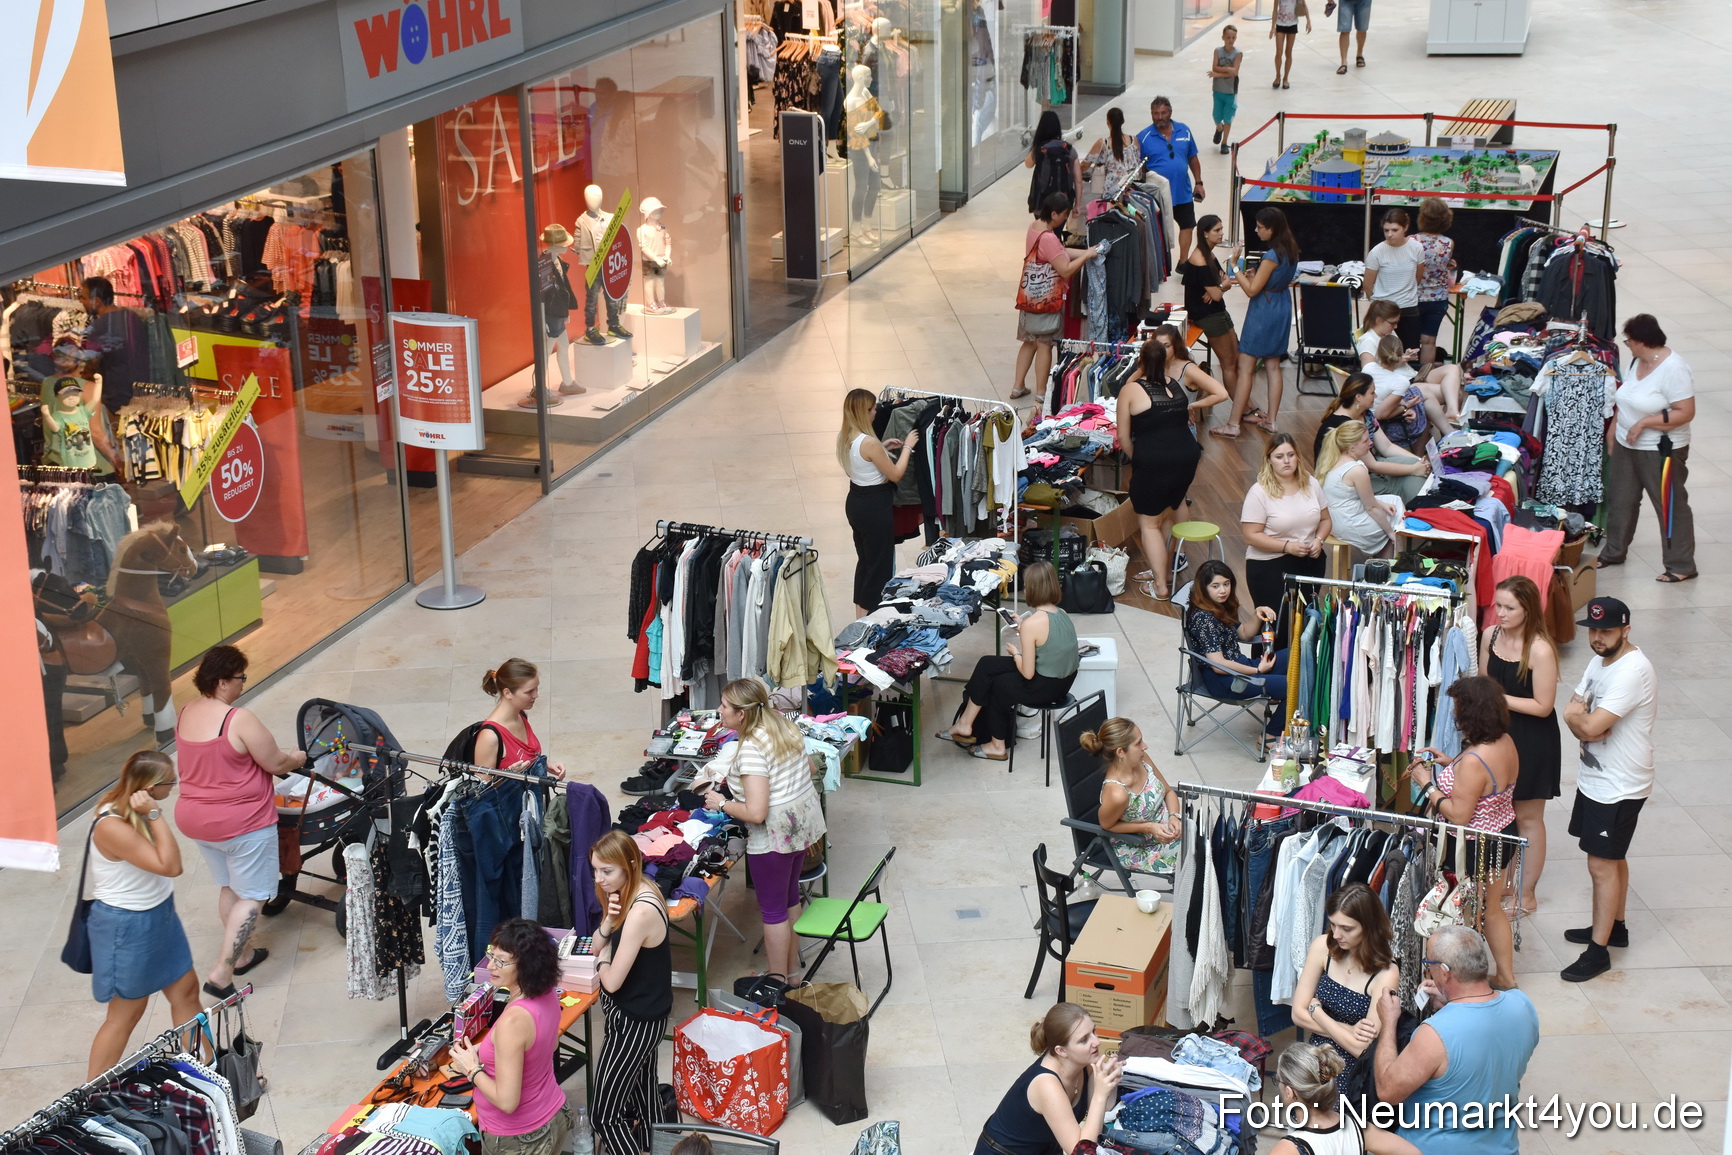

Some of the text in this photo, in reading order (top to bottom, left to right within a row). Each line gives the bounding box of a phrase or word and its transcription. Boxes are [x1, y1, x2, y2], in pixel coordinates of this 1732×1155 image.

[354, 0, 511, 79] WÖHRL
[608, 252, 628, 274] 50%
[609, 268, 628, 283] REDUZIERT
[402, 338, 453, 353] SOMMER
[403, 350, 455, 371] SALE
[196, 452, 212, 479] 25%
[211, 399, 245, 454] zusätzlich
[418, 431, 446, 440] WÖHRL
[227, 444, 244, 459] BIS ZU
[221, 458, 254, 490] 50%
[223, 478, 255, 501] REDUZIERT
